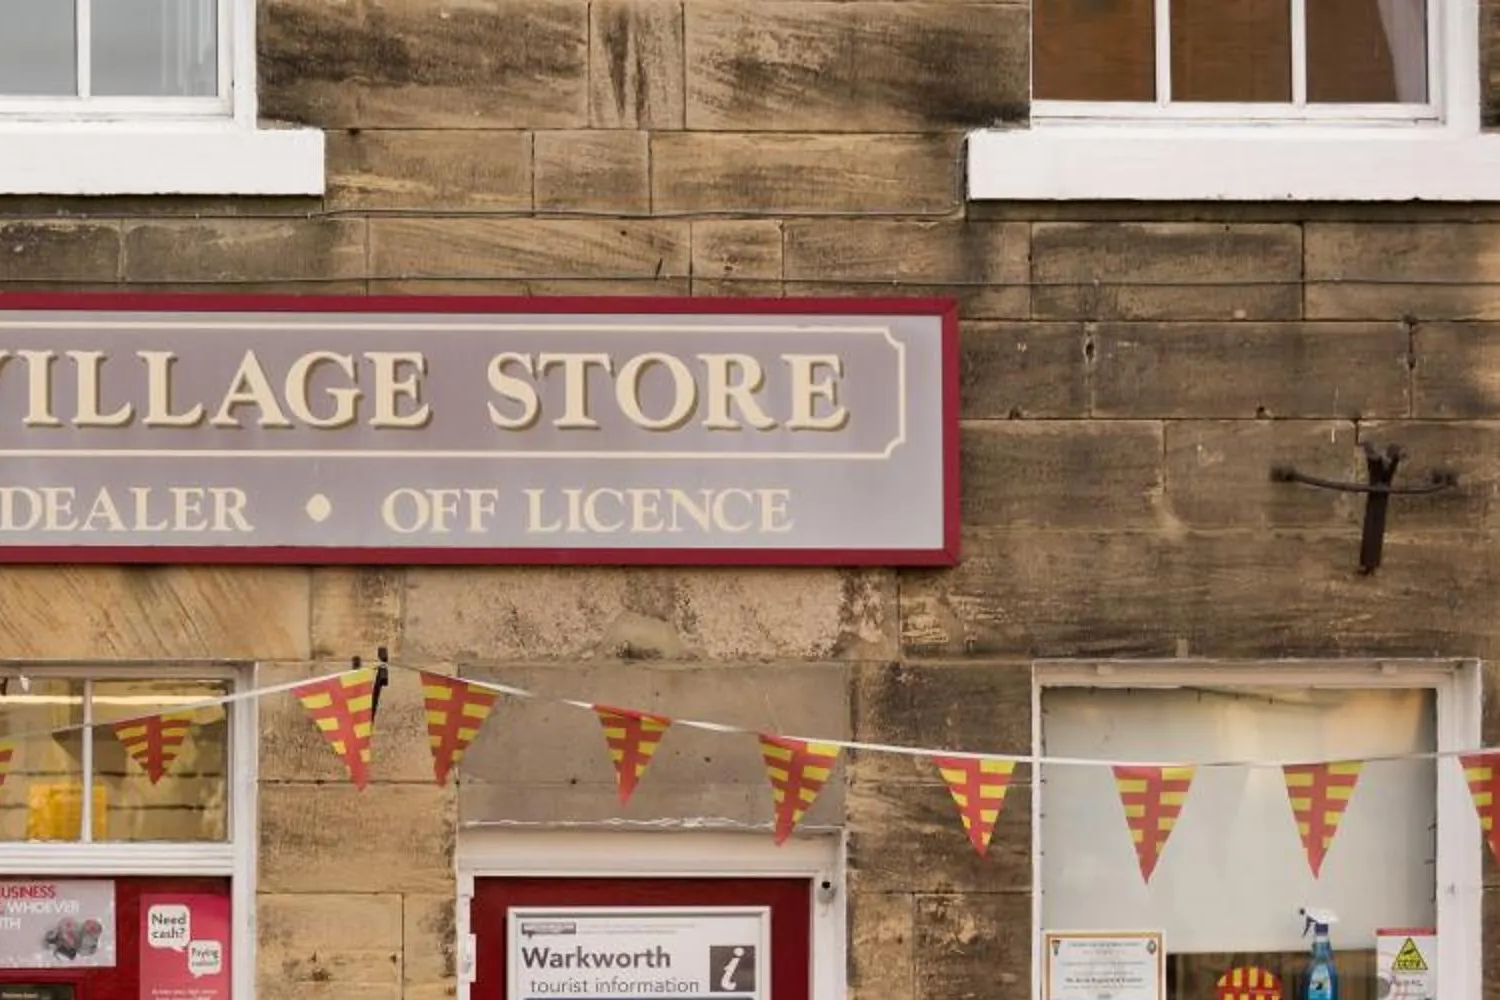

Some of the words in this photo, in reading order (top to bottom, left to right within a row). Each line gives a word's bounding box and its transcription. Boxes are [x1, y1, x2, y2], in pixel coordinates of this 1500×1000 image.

[487, 352, 849, 434] STORE
[382, 487, 500, 534] OFF
[526, 489, 794, 534] LICENCE
[6, 900, 79, 913] WHOEVER
[151, 913, 187, 925] Need
[151, 926, 185, 940] cash?
[522, 946, 671, 969] Warkworth
[531, 978, 588, 993] tourist
[595, 977, 700, 993] information
